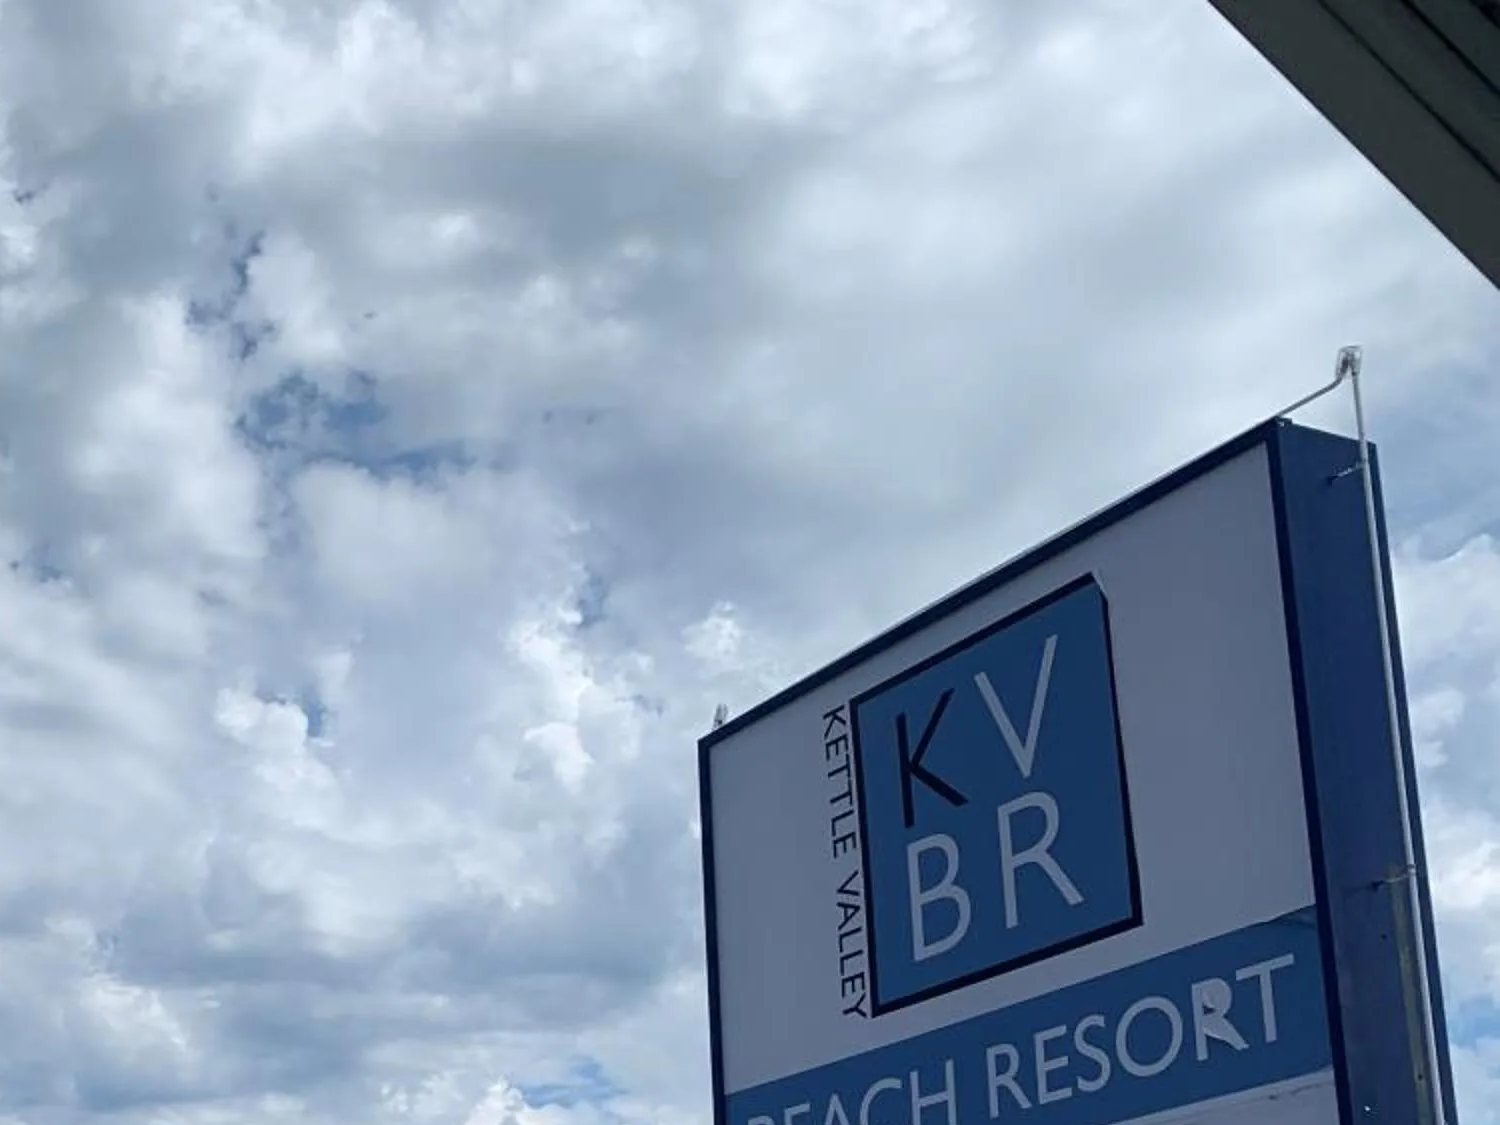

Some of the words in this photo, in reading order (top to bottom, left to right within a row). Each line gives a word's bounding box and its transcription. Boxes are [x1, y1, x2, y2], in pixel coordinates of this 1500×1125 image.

[822, 704, 857, 858] KETTLE
[836, 870, 867, 1017] VALLEY
[987, 955, 1295, 1120] RESORT
